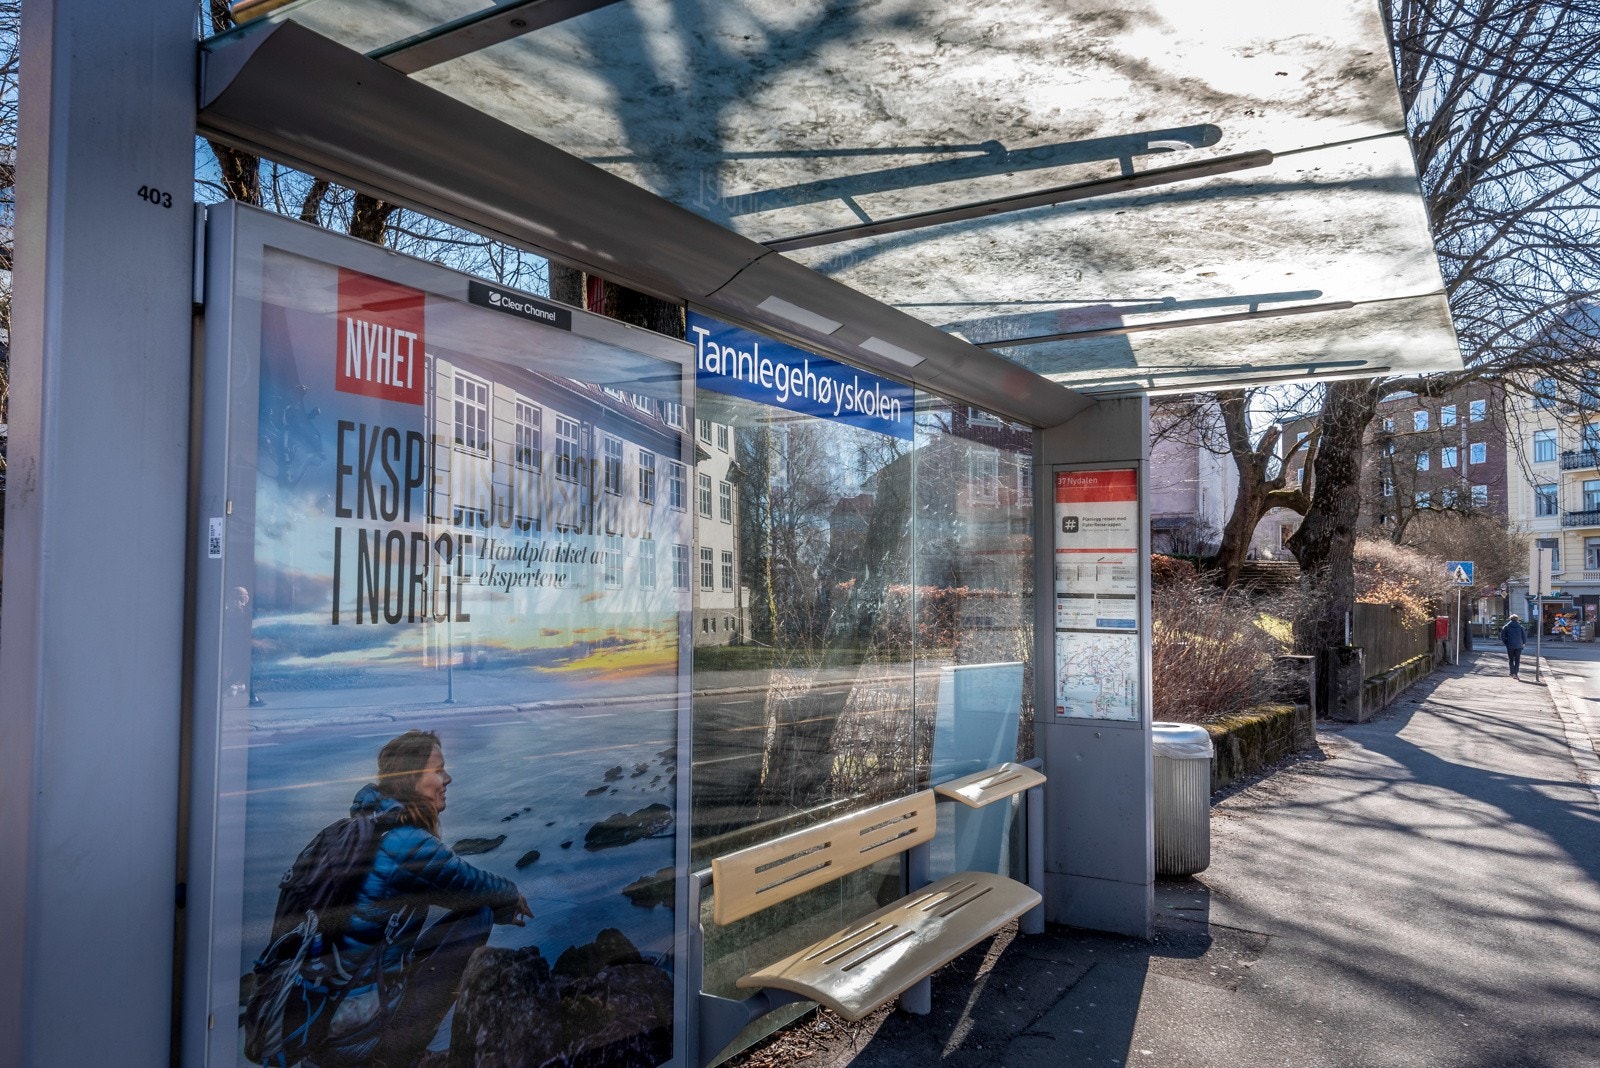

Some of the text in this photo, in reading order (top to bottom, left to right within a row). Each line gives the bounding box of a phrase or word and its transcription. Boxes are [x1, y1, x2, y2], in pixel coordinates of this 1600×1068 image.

[137, 185, 172, 208] 403
[502, 296, 556, 321] Clear Channel
[345, 317, 418, 389] NYHET
[692, 325, 901, 423] Tannlegehøyskolen
[1057, 477, 1098, 486] 37 Nydalen
[479, 537, 608, 568] Håndplukket av
[332, 527, 471, 625] I NORGE
[478, 563, 567, 593] ekspertene
